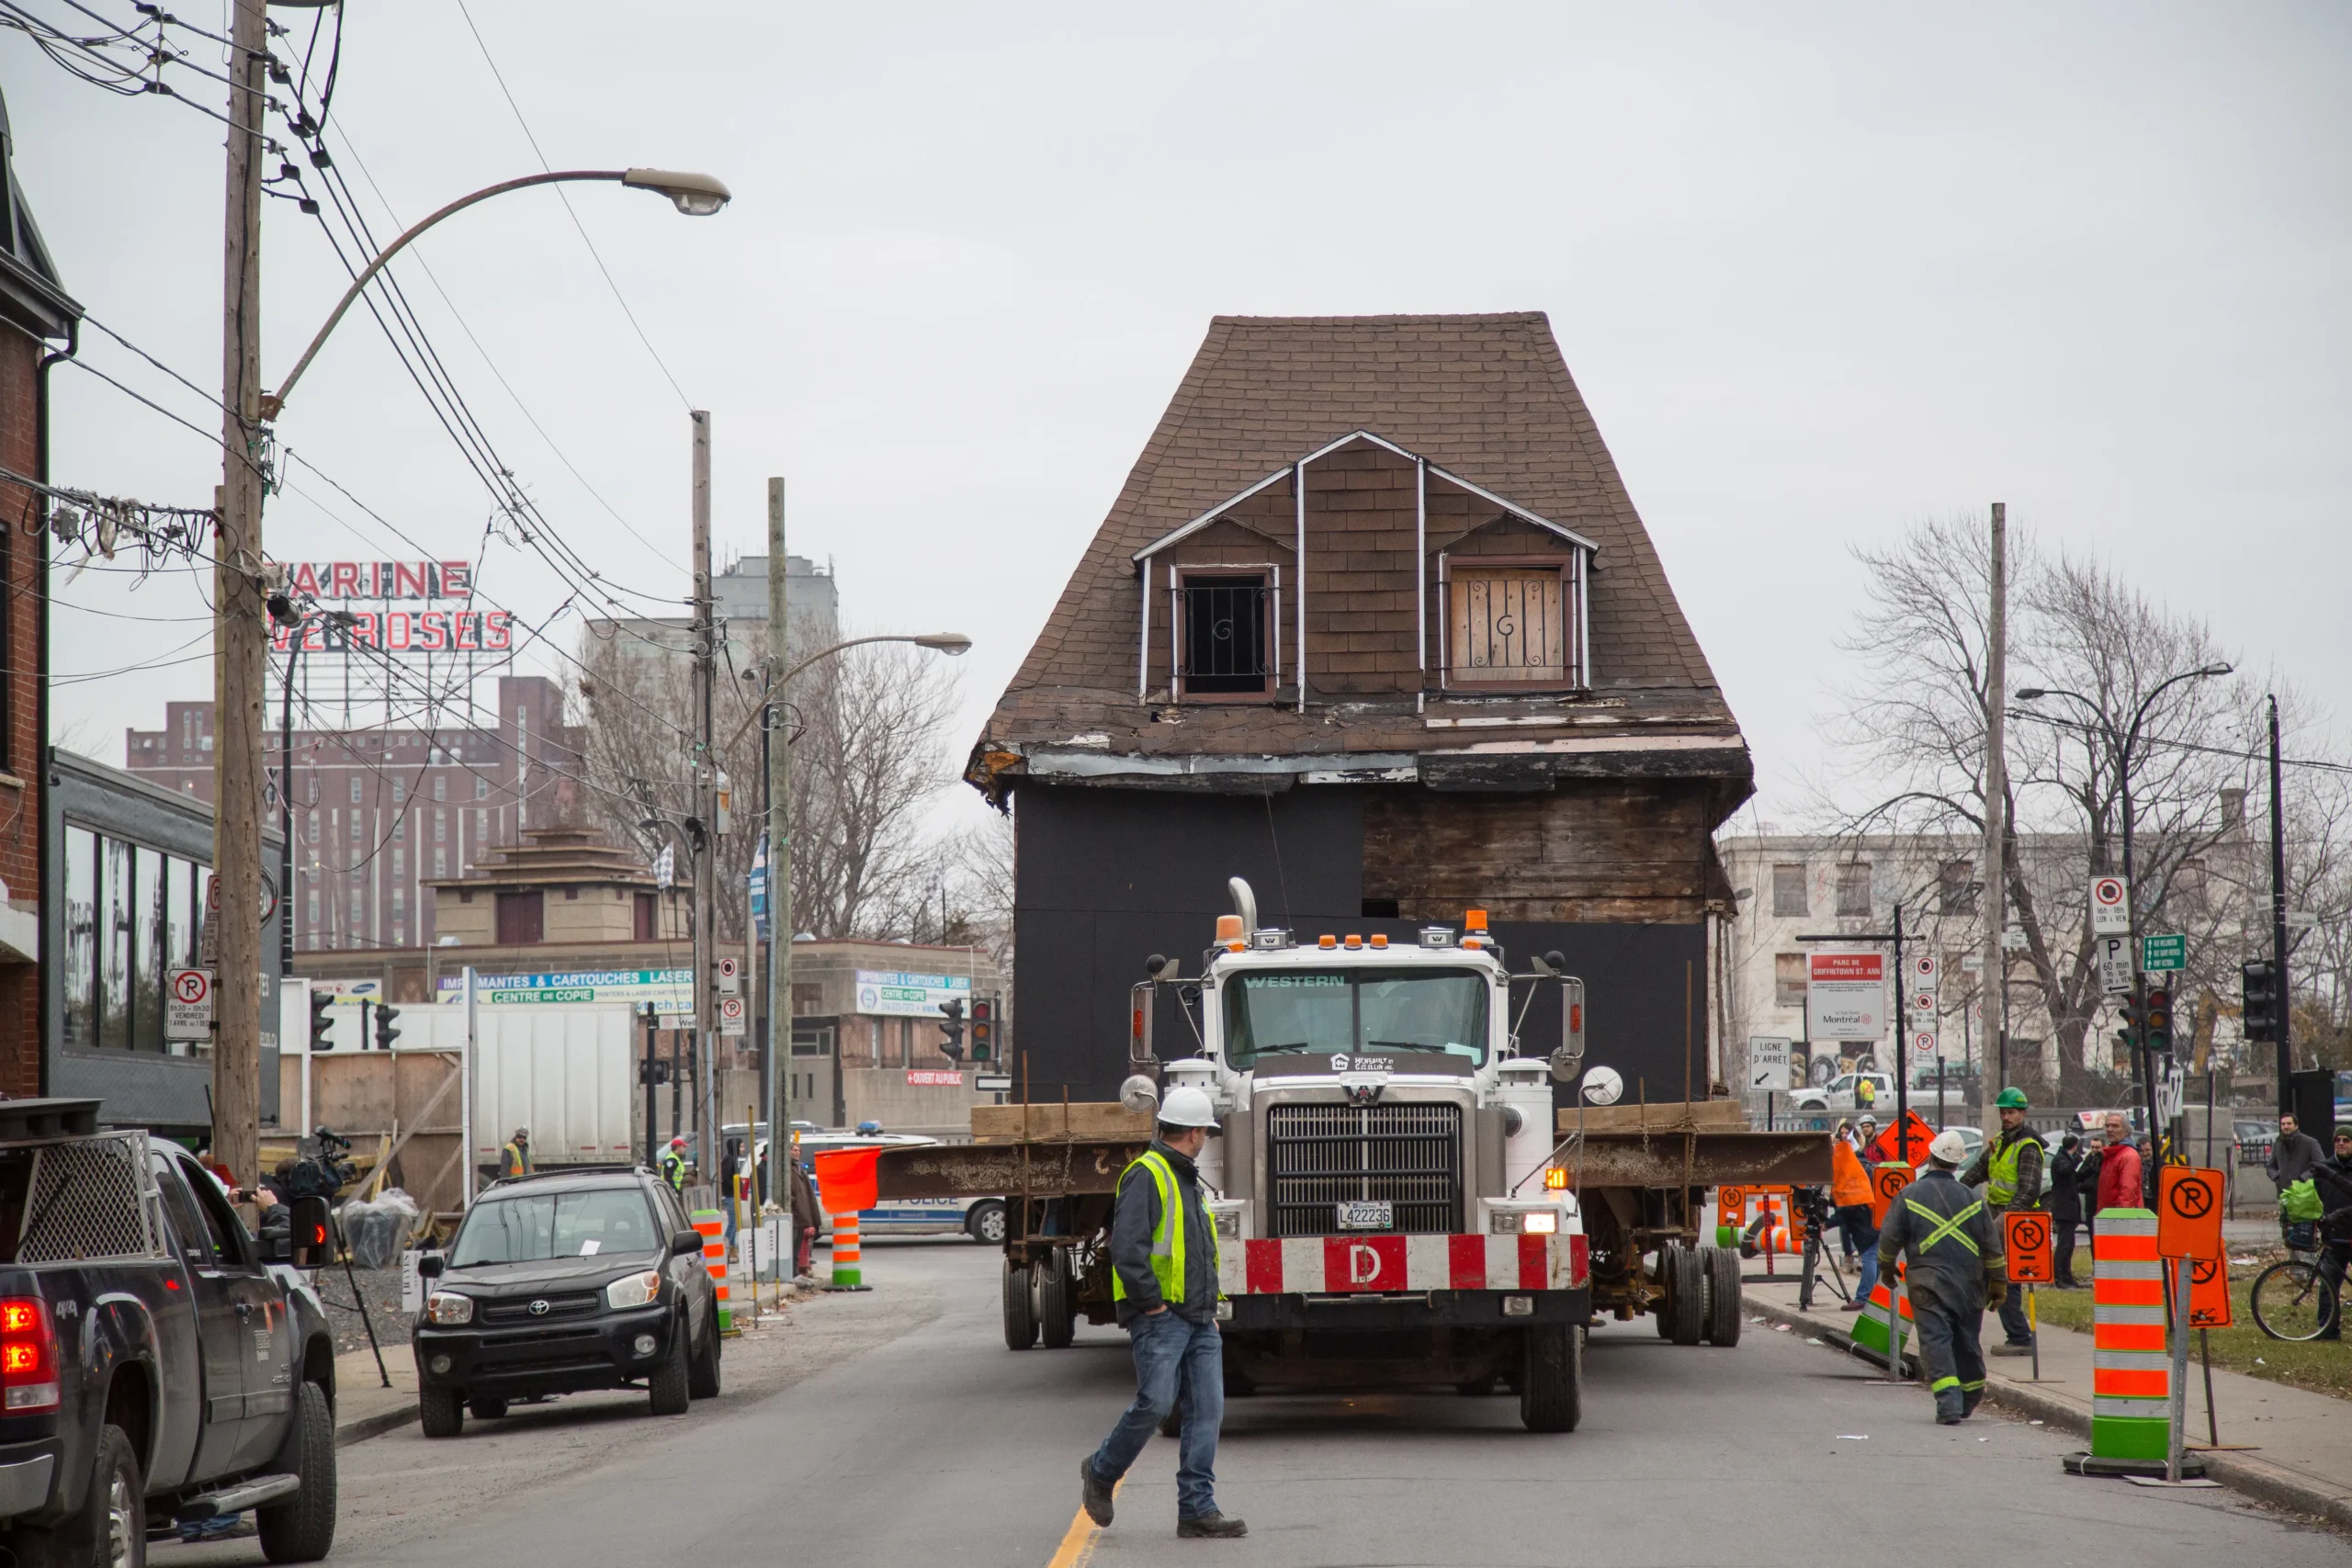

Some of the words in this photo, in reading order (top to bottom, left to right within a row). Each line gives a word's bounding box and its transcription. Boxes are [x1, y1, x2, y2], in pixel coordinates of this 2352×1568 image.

[264, 560, 470, 598] ARINE
[2109, 940, 2120, 959] P
[2103, 963, 2113, 971] 60
[2117, 961, 2130, 969] min
[444, 976, 529, 989] IMPMANTES
[537, 976, 546, 987] &
[552, 972, 639, 987] CARTOUCHES
[650, 970, 693, 983] LASER
[859, 971, 898, 985] IMPRIMANTES
[908, 975, 944, 987] CARTOUCHES
[948, 977, 967, 988] LASER
[1244, 976, 1345, 988] WESTERN
[494, 992, 540, 1003] CENTRE
[556, 990, 592, 1000] COPIE
[882, 988, 903, 999] CENTRE
[910, 990, 925, 1001] COPIE
[1823, 1015, 1860, 1023] Montréal
[913, 1073, 935, 1084] OUVERT
[935, 1073, 943, 1084] AU
[943, 1074, 962, 1084] PUBLIC
[1340, 1209, 1390, 1223] L422236
[1351, 1245, 1381, 1283] D
